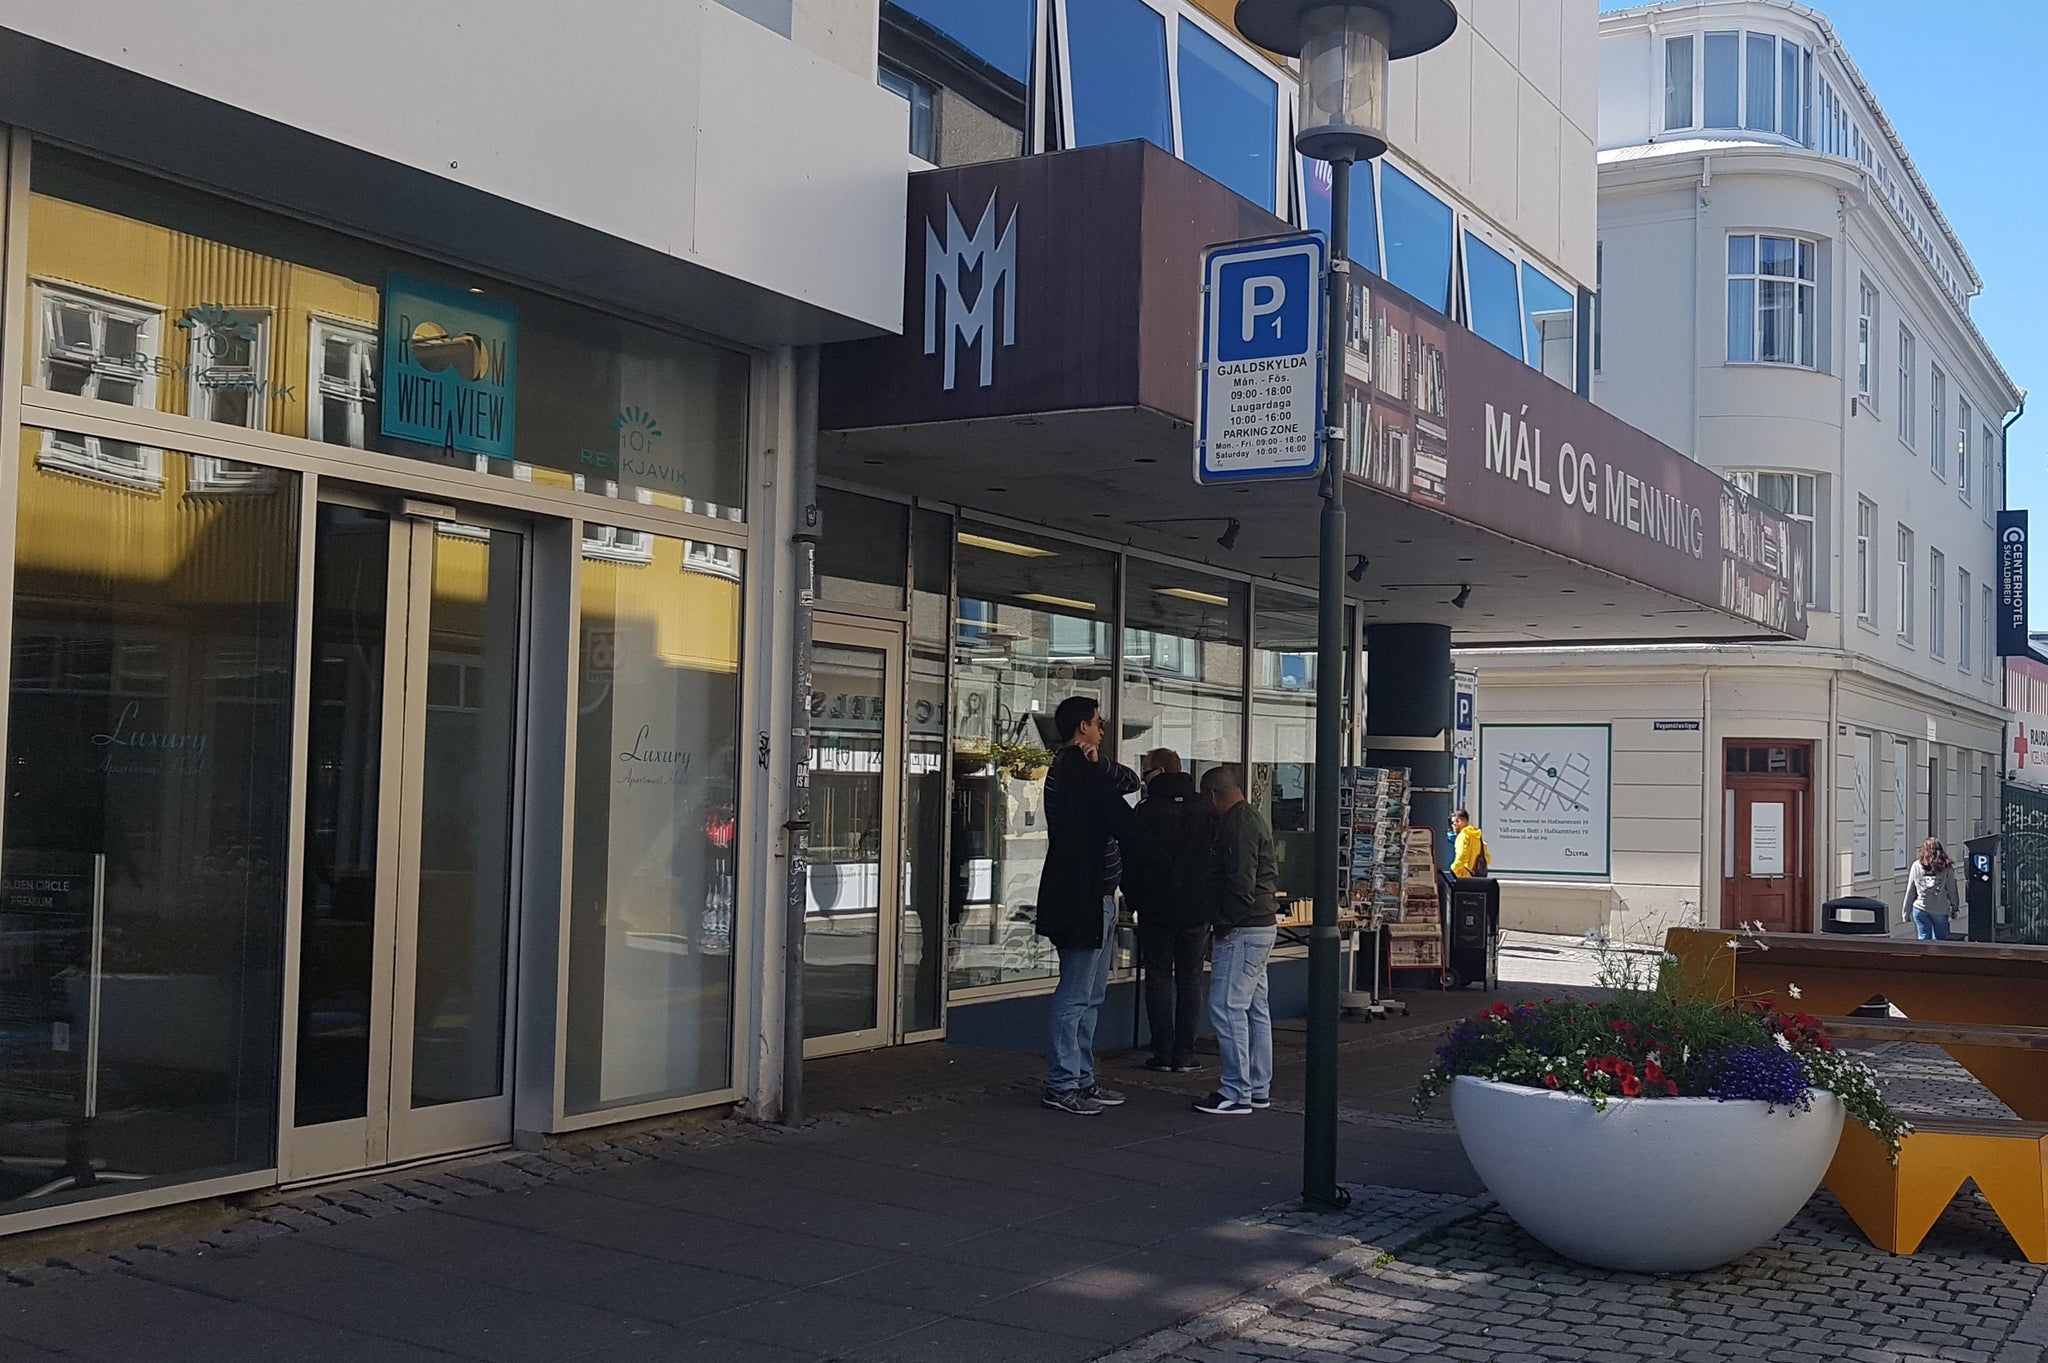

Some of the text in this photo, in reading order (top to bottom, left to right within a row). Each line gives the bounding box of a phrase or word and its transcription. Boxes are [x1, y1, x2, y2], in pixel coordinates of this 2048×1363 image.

[1242, 275, 1286, 342] P 1
[1217, 357, 1307, 376] GJALDSKYLDA
[133, 351, 296, 402] REYKJAVIK
[1233, 377, 1258, 387] Mán.
[1231, 389, 1257, 400] 09:00
[1266, 385, 1292, 396] 18:00
[1231, 400, 1291, 413] Laugardaga
[398, 372, 504, 458] WITH A VIEW
[1230, 414, 1256, 425] 10:00
[1265, 411, 1291, 422] 16:00
[1223, 424, 1298, 439] PARKING ZONE
[1215, 442, 1234, 450] Mon.
[1241, 440, 1254, 448] Fri.
[1285, 435, 1307, 443] 18:00
[1215, 451, 1250, 459] Saturday
[1256, 447, 1278, 456] 10:00
[1485, 403, 1704, 560] MÁL OG MENNING
[2013, 543, 2023, 629] CENTERHOTEL
[1460, 699, 1469, 723] P
[91, 700, 207, 762] Luxury
[619, 724, 691, 773] Luxury
[1977, 855, 1987, 869] P
[3, 880, 70, 892] OLDEN CIRCLE
[11, 895, 53, 907] PREMIUM
